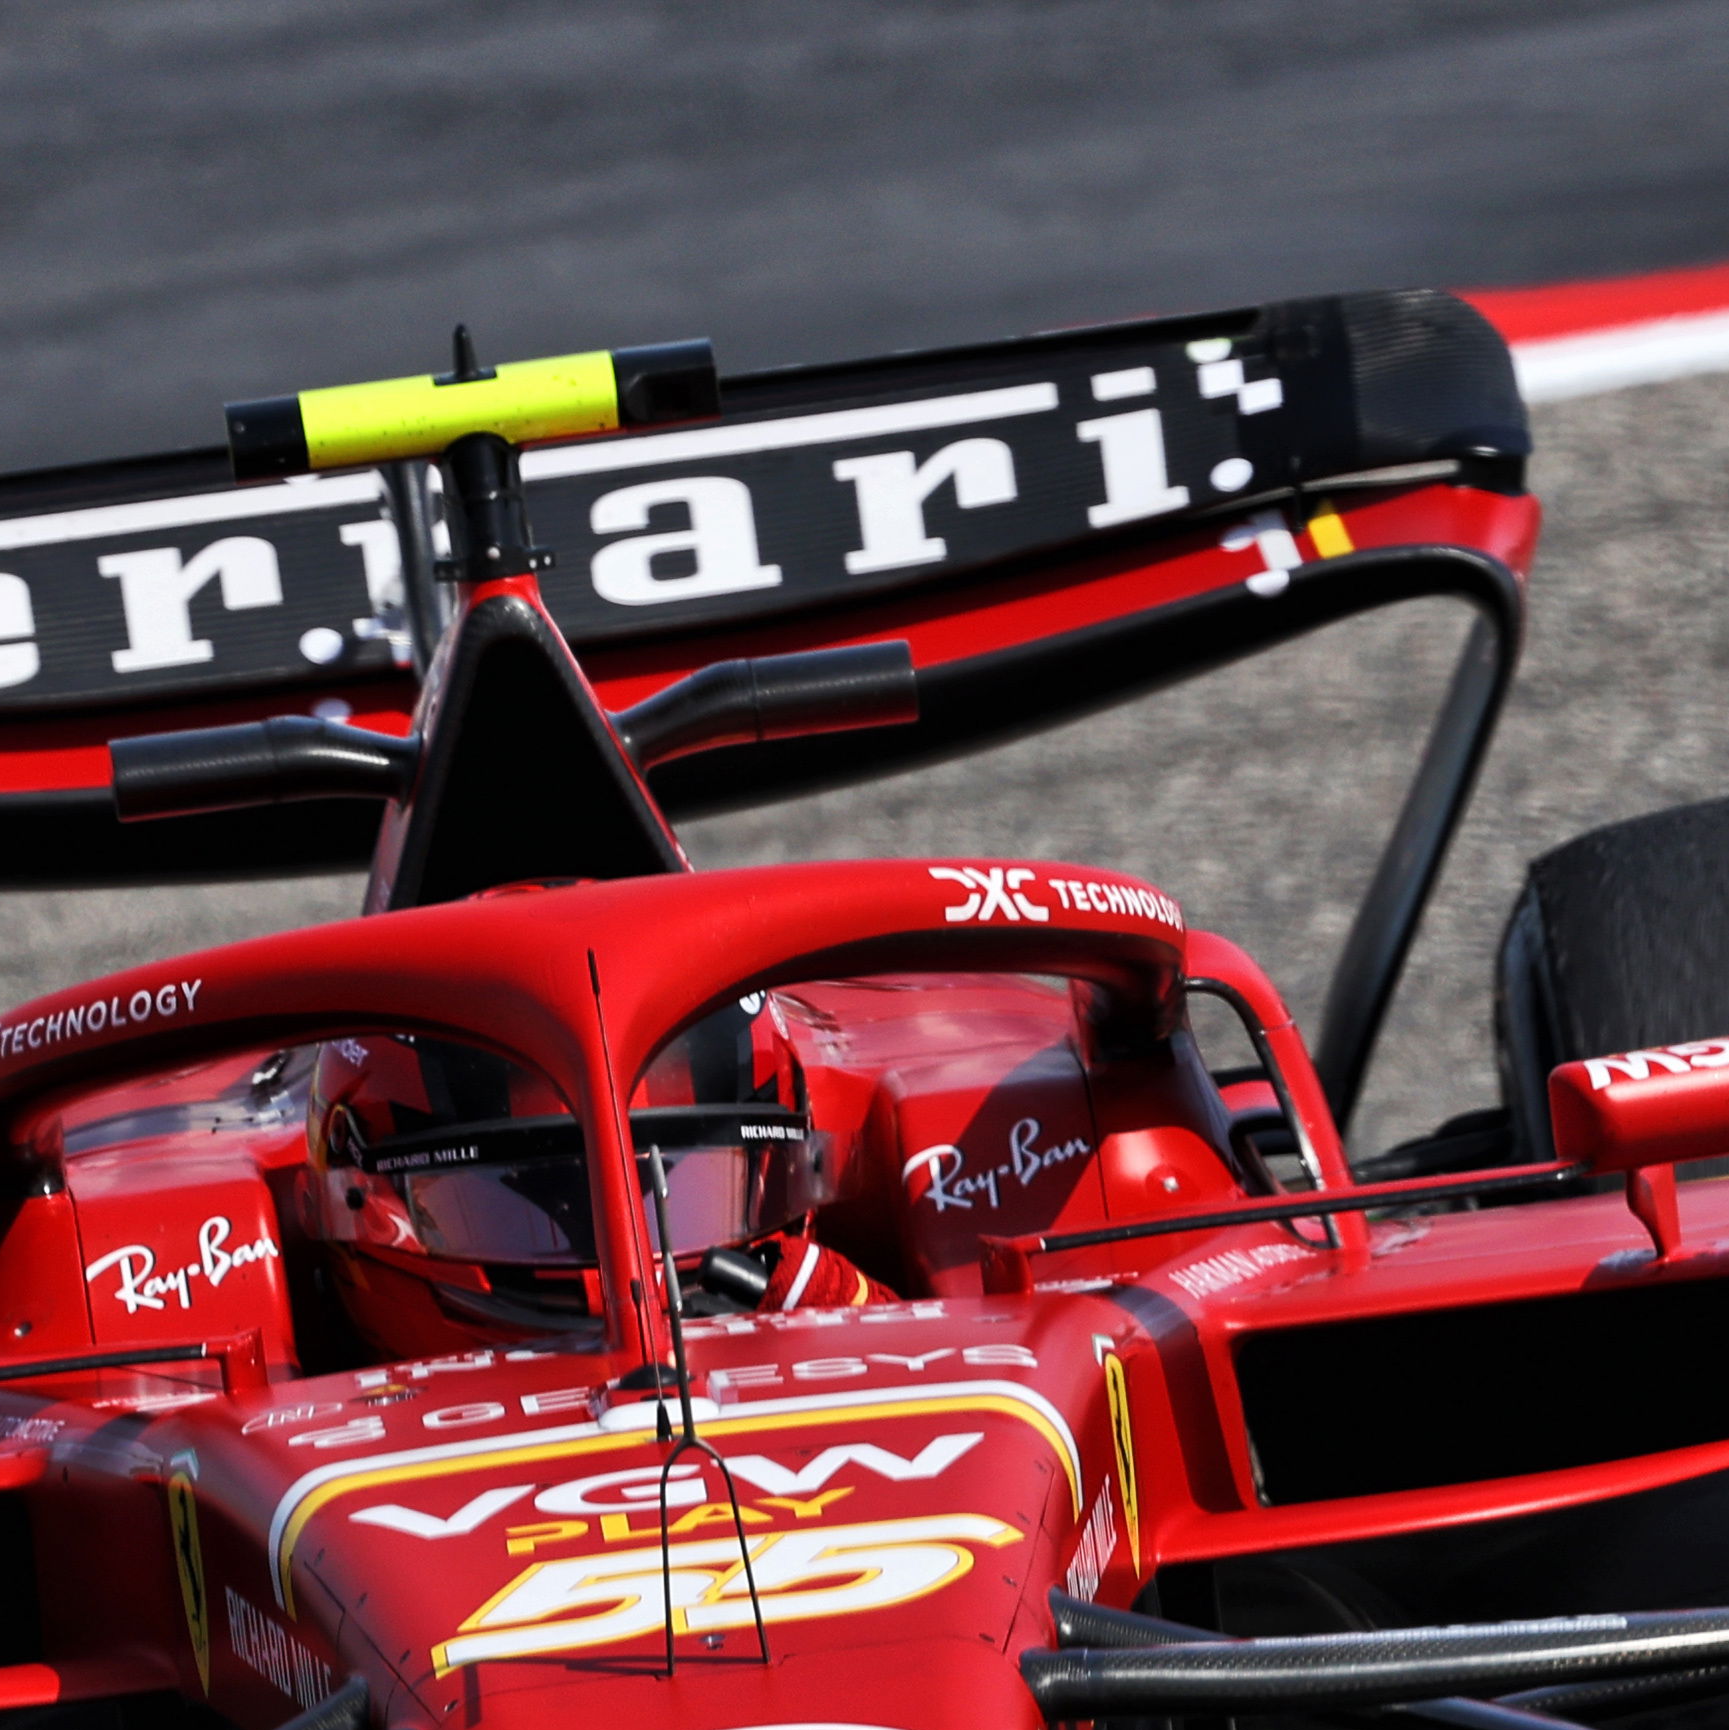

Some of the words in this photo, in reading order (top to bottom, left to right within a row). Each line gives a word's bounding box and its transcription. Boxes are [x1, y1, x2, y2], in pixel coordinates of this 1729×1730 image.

[928, 867, 1049, 922] DXC
[0, 978, 203, 1057] TECHNOLOGY
[434, 1145, 479, 1164] MILLE
[900, 1117, 1092, 1213] Ray-Ban
[85, 1215, 279, 1315] Ray-Ban
[421, 1343, 1038, 1429] GEESYS
[348, 1430, 984, 1540] VGW
[506, 1486, 858, 1558] PLAY
[225, 1584, 293, 1699] RICHARD
[430, 1514, 1025, 1680] 55
